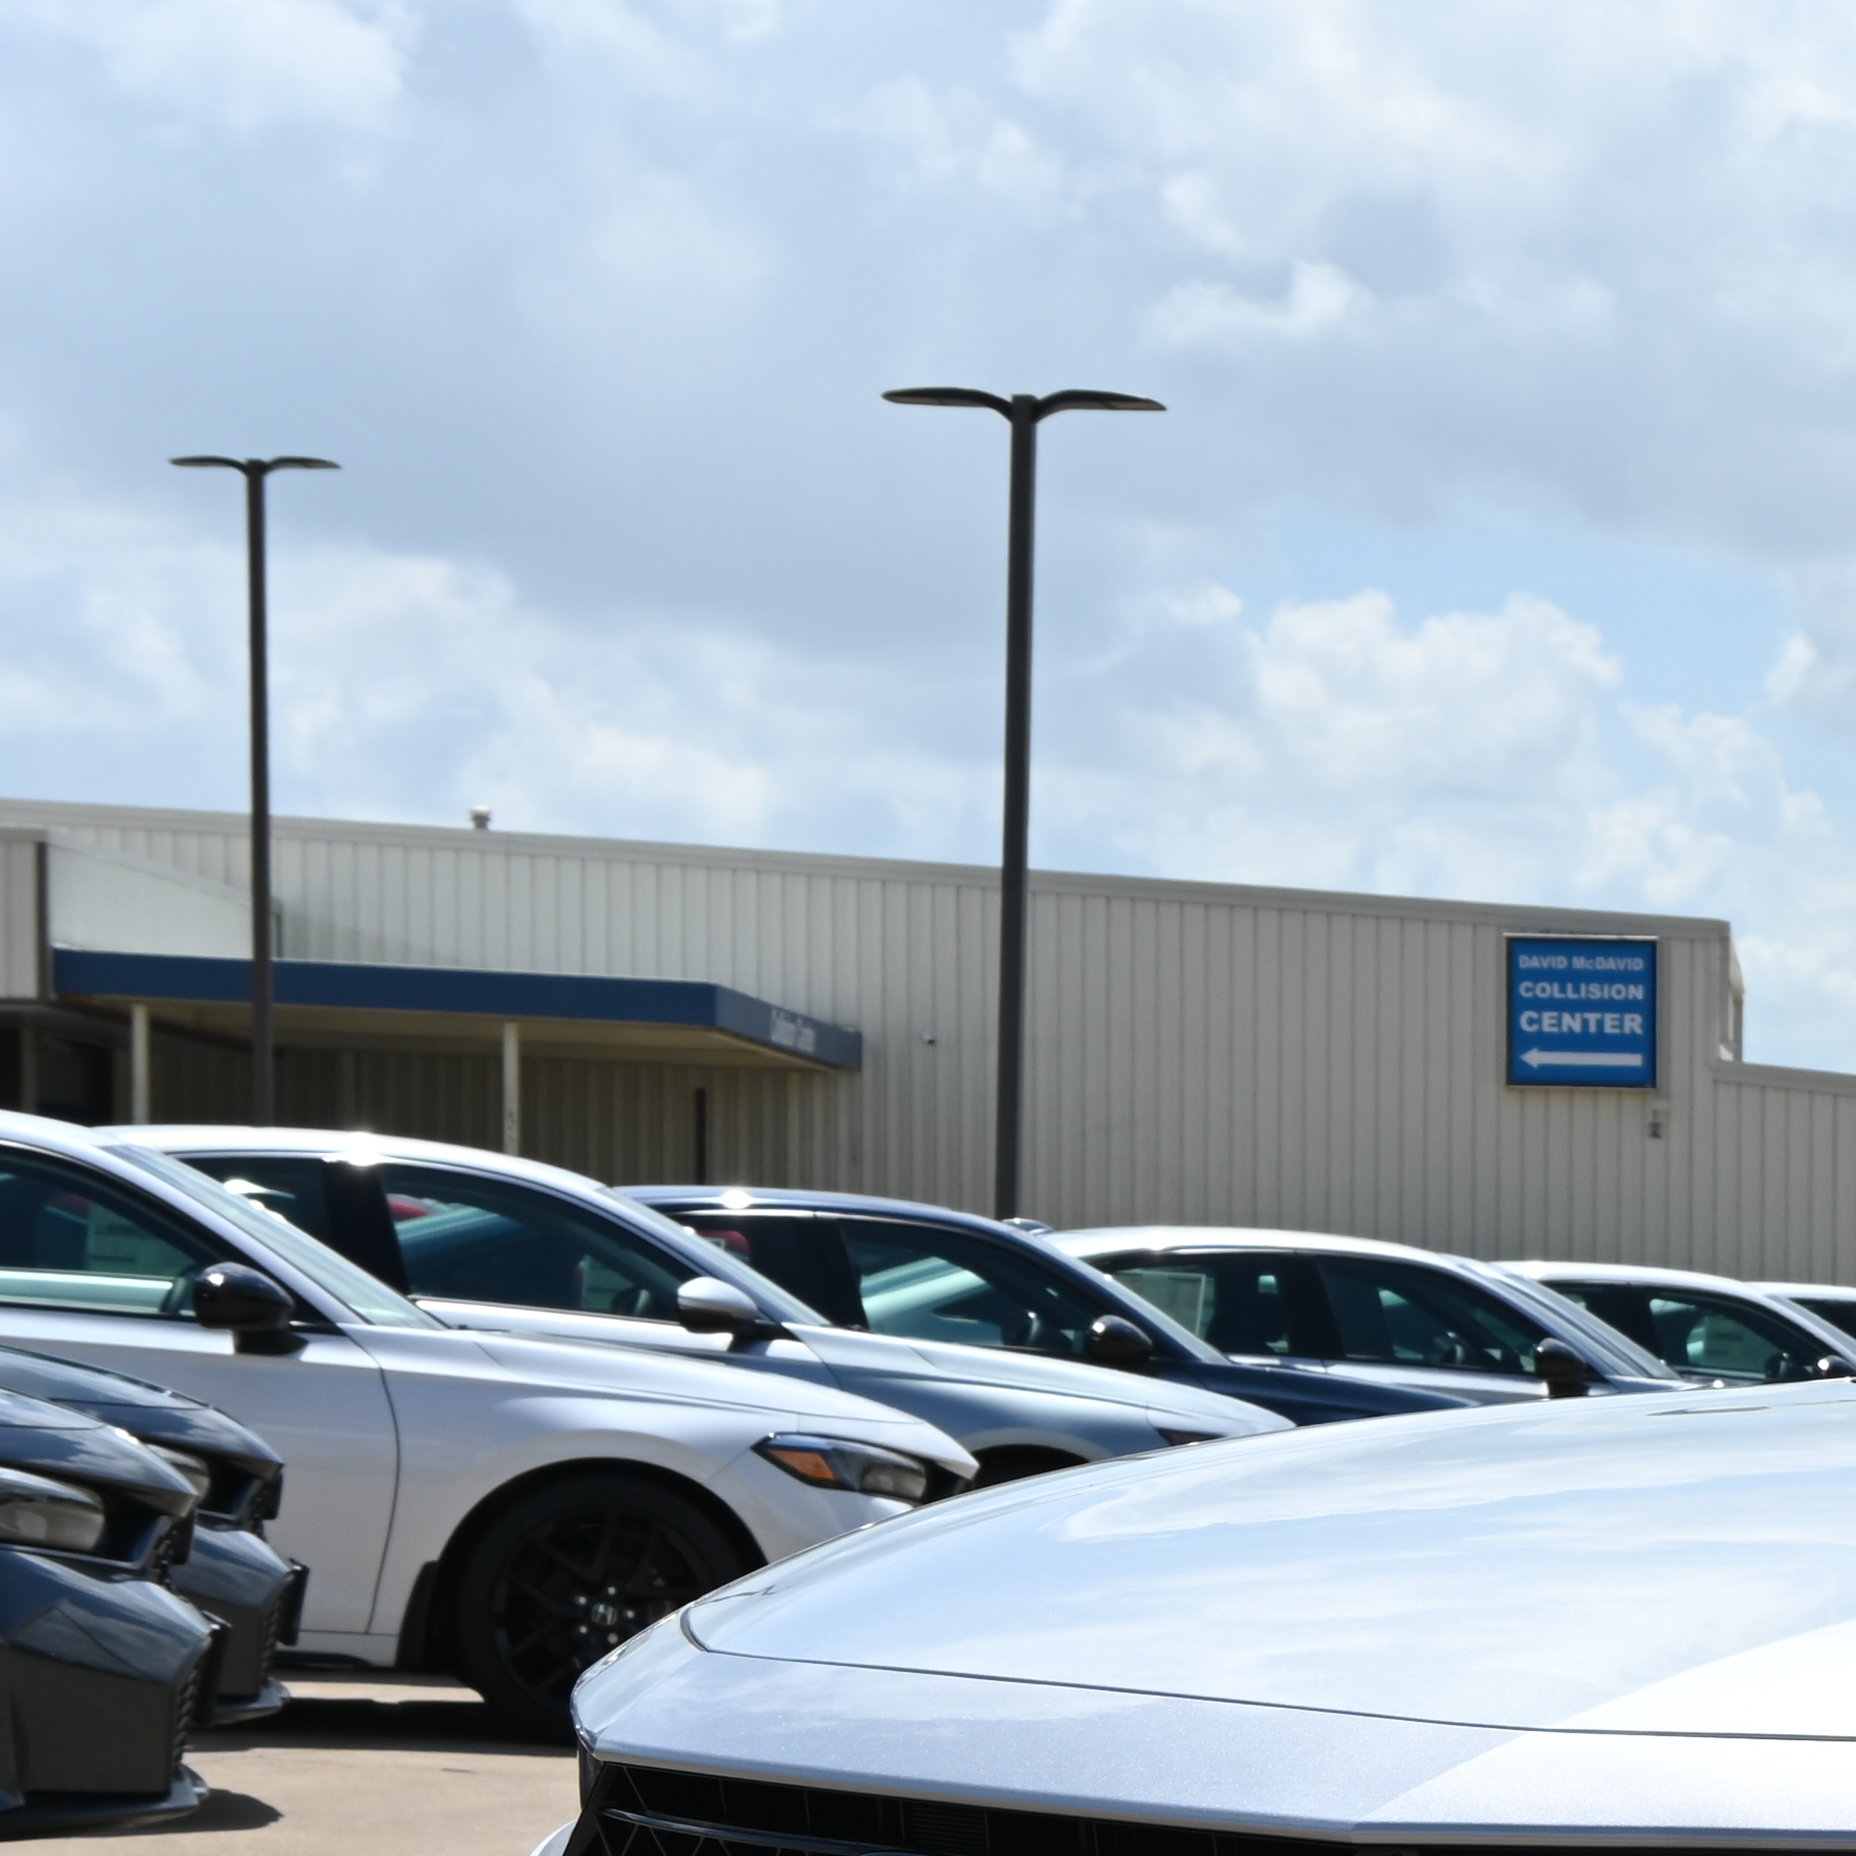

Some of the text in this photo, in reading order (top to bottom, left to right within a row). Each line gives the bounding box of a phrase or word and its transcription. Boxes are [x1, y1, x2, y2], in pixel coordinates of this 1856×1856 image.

[1519, 955, 1644, 970] DAVID McDAVID
[1519, 981, 1644, 1000] COLLISION
[1520, 1011, 1644, 1034] CENTER
